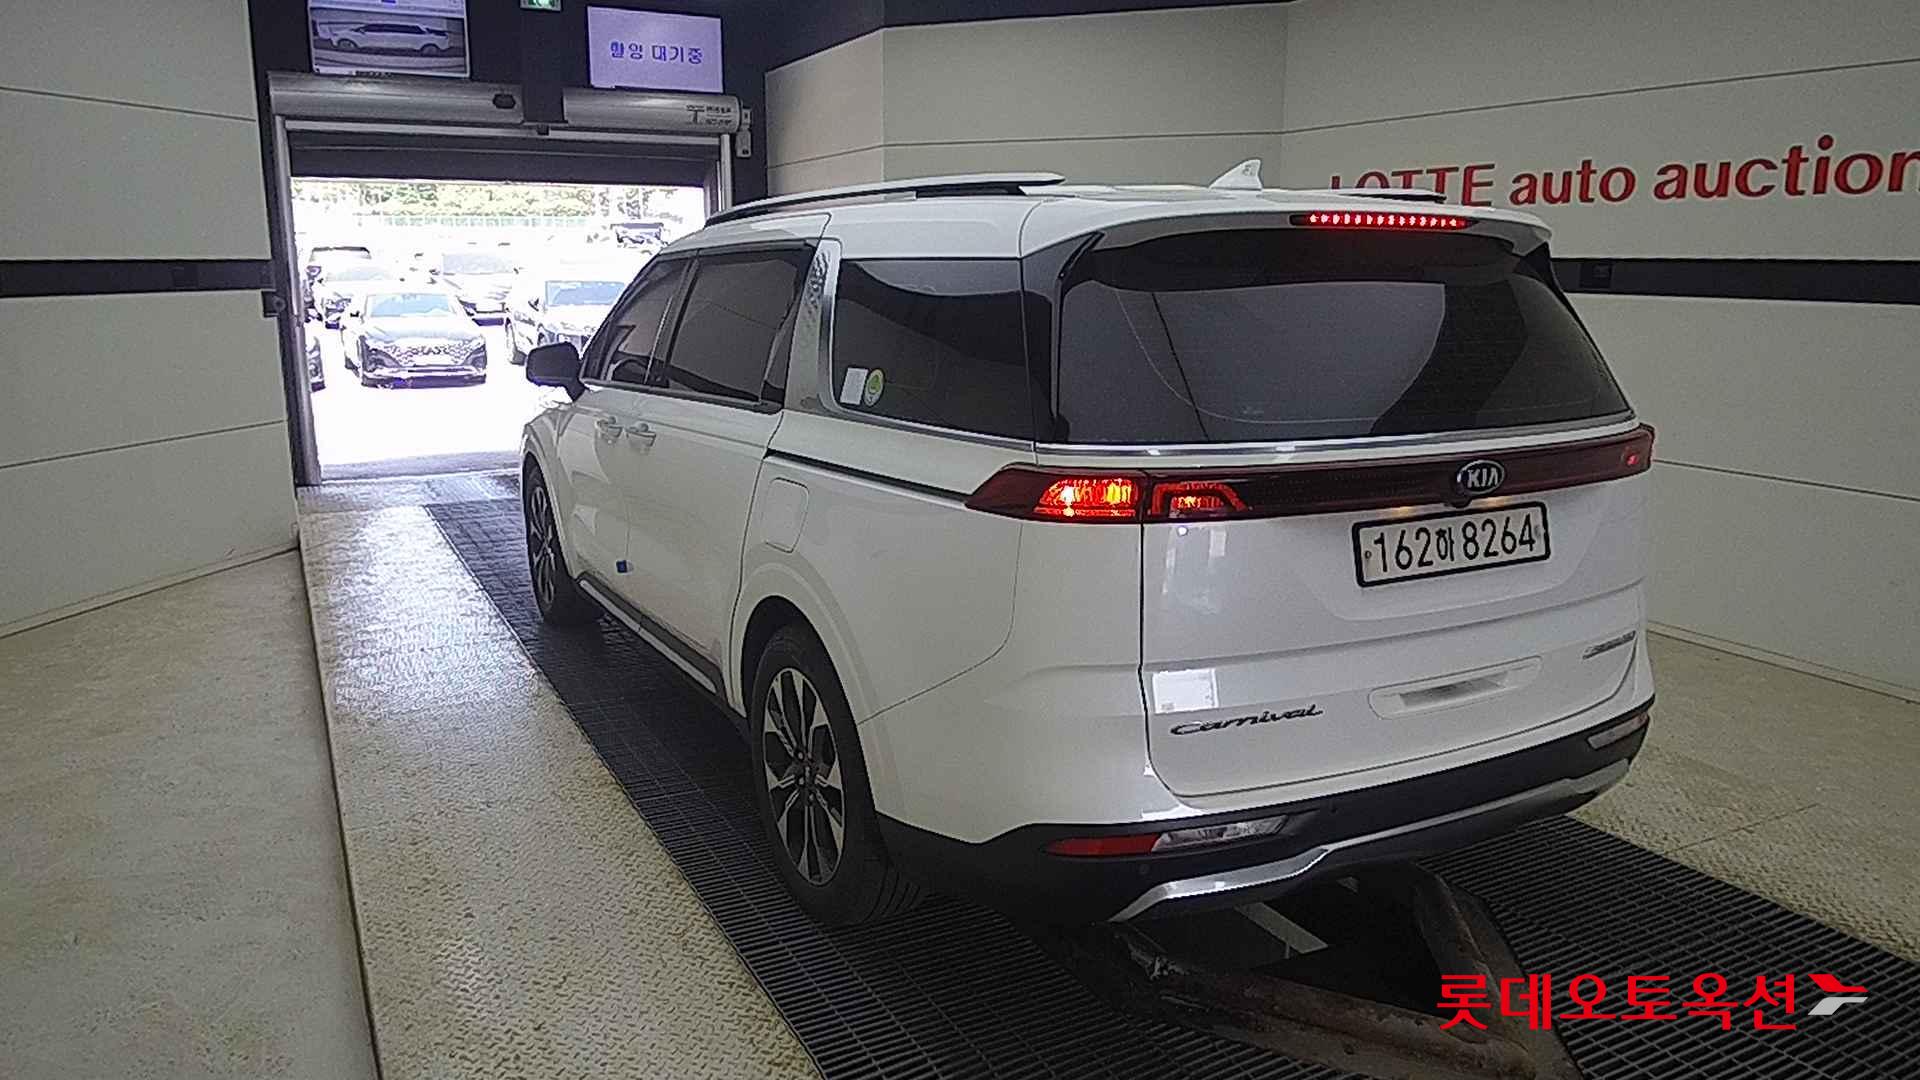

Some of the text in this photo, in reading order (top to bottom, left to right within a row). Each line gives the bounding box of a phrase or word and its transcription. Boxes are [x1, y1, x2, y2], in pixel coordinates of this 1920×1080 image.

[1331, 134, 1920, 207] TTE auto auction
[1467, 468, 1499, 488] KIA
[1170, 704, 1324, 735] Carnival
